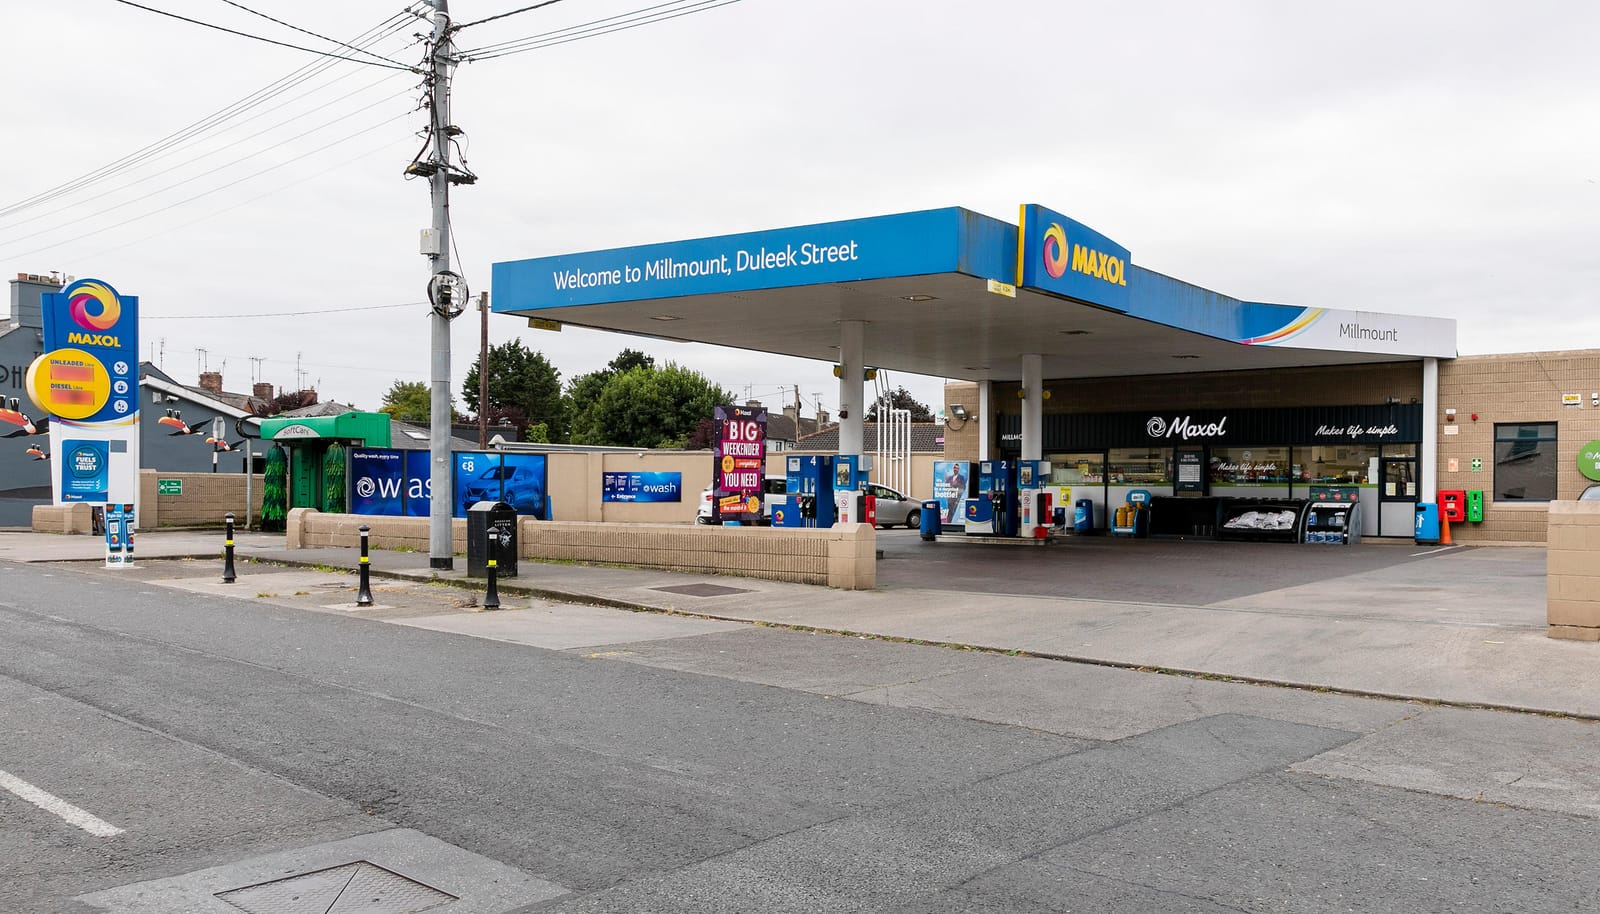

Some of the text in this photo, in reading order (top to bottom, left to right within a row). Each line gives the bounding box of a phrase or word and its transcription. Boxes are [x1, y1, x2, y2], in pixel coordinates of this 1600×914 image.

[553, 239, 859, 290] Welcome to Millmount, Duleek Street
[1071, 243, 1127, 287] MAXOL
[67, 331, 122, 348] MAXOL
[1339, 322, 1398, 342] Millmount
[50, 359, 84, 367] UNLEADED
[729, 421, 758, 441] BIG
[1165, 415, 1228, 441] Maxol
[1314, 424, 1399, 439] Makes life simple
[722, 442, 760, 457] WEEKENDER
[462, 461, 474, 472] €8
[809, 456, 817, 466] 4
[1001, 460, 1007, 470] 2
[1217, 462, 1239, 472] Makes
[377, 477, 432, 499] was
[650, 482, 677, 493] wash
[724, 473, 758, 488] YOU NEED
